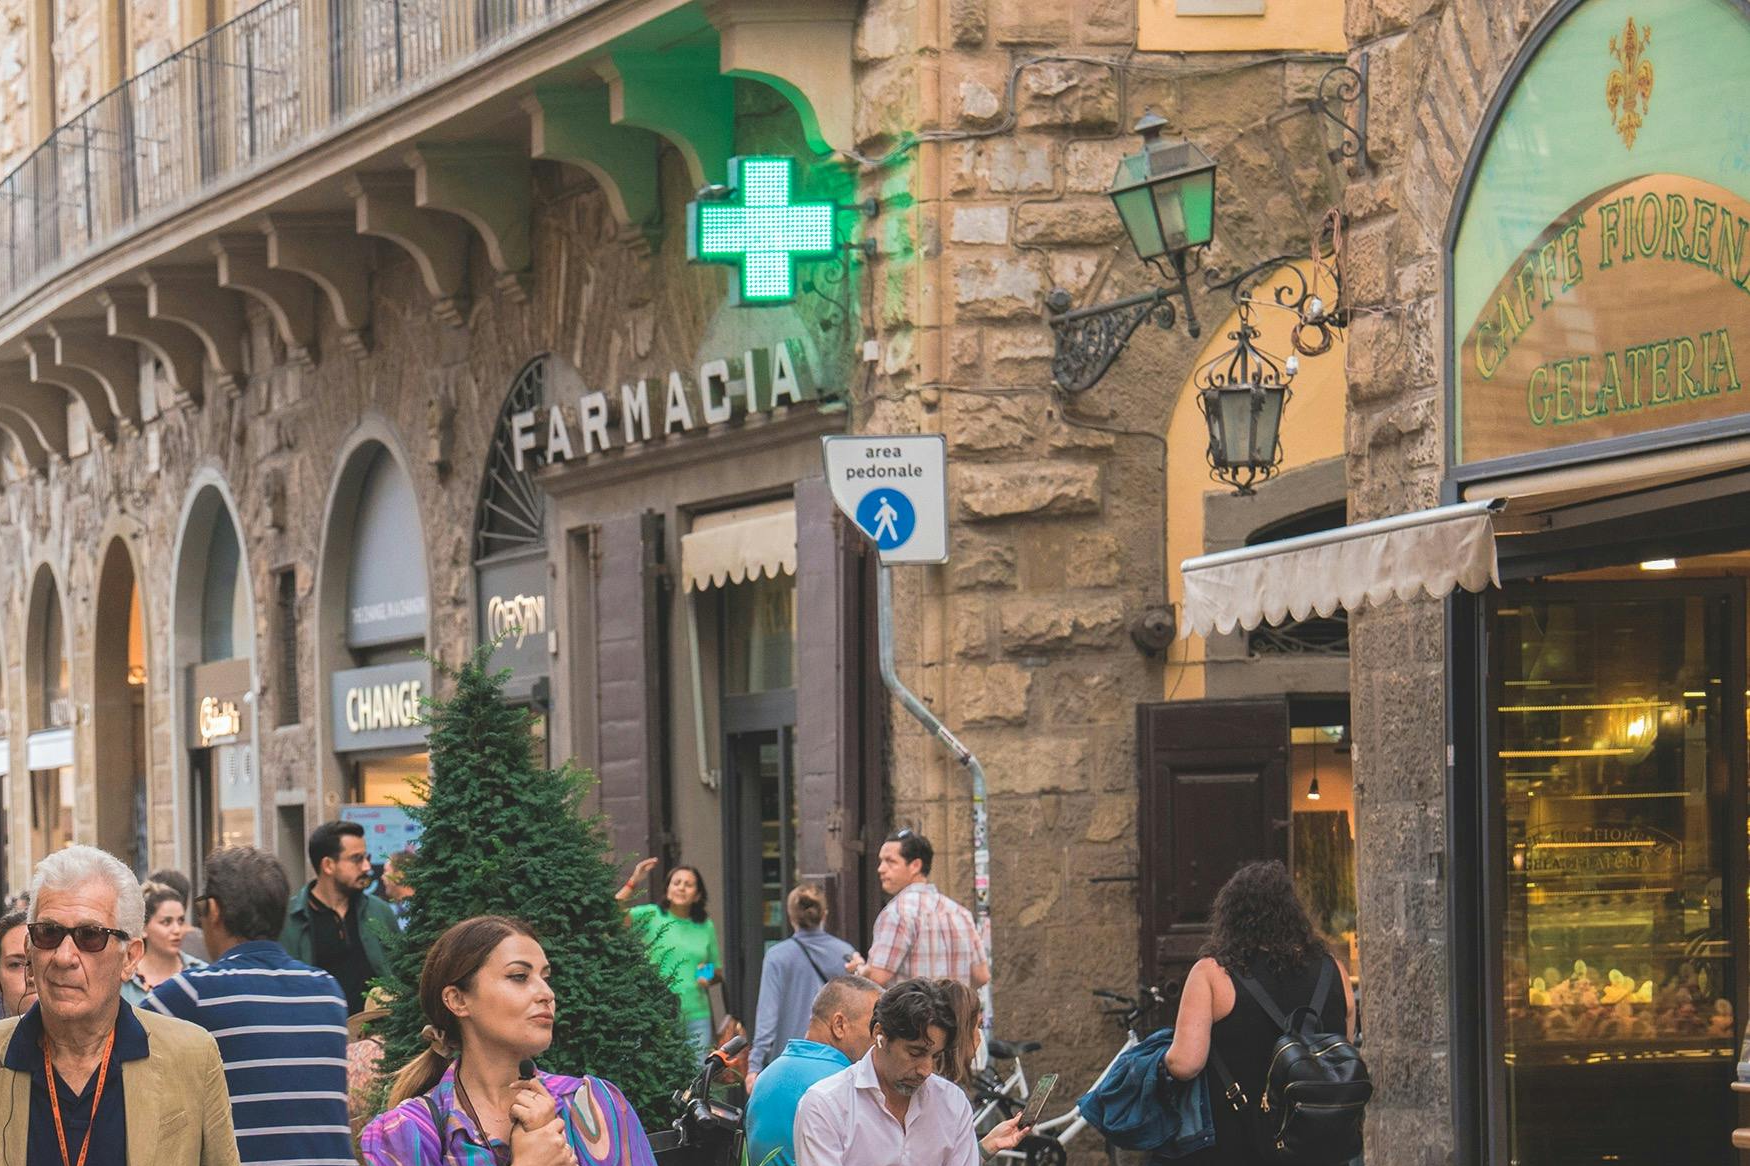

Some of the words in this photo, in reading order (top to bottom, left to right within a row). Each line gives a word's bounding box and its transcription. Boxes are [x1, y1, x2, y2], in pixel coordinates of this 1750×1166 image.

[1527, 328, 1741, 426] GELATERIA
[511, 341, 801, 473] FARMACIA
[846, 464, 923, 480] pedonale
[865, 447, 902, 458] area
[346, 680, 422, 733] CHANGE
